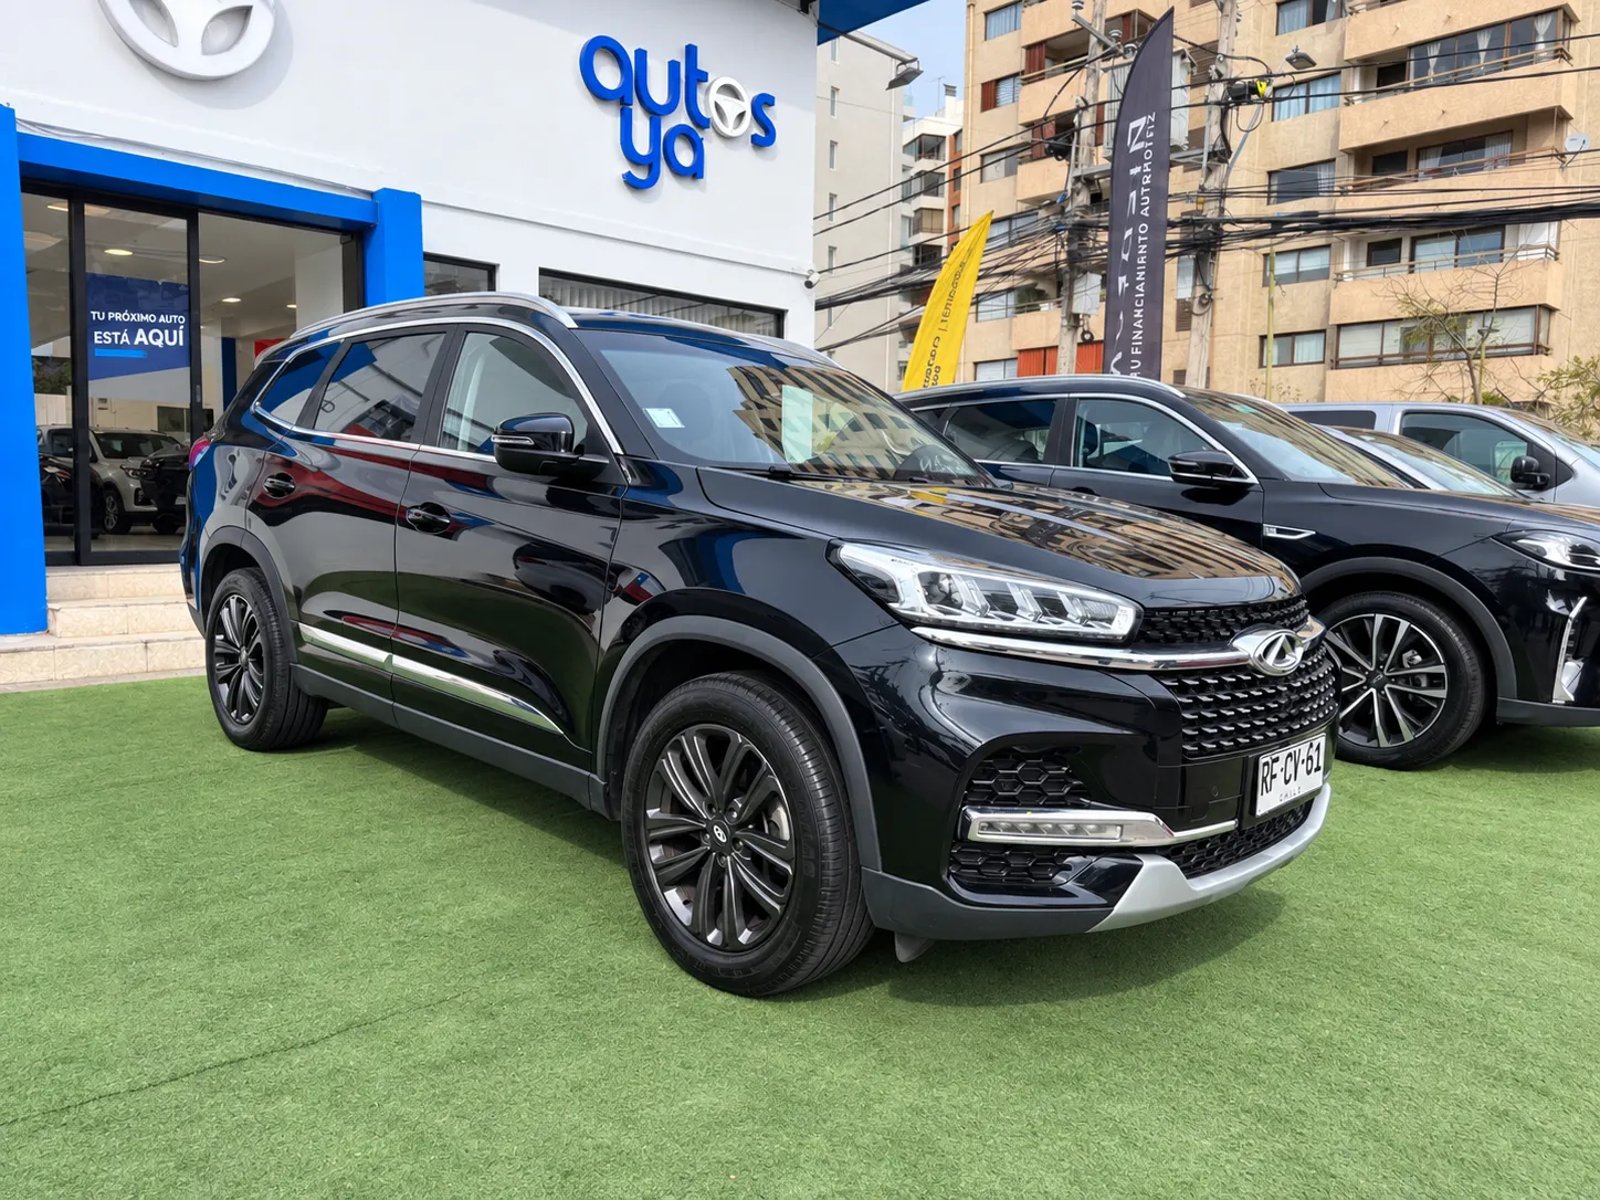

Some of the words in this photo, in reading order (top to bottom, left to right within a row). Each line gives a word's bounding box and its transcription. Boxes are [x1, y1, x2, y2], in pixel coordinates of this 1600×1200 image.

[579, 35, 777, 148] autos
[619, 106, 705, 190] ya
[90, 310, 105, 321] TU
[107, 309, 157, 323] PRÓXIMO
[158, 314, 186, 324] AUTO
[94, 329, 131, 345] ESTÁ
[134, 325, 185, 348] AQUÍ
